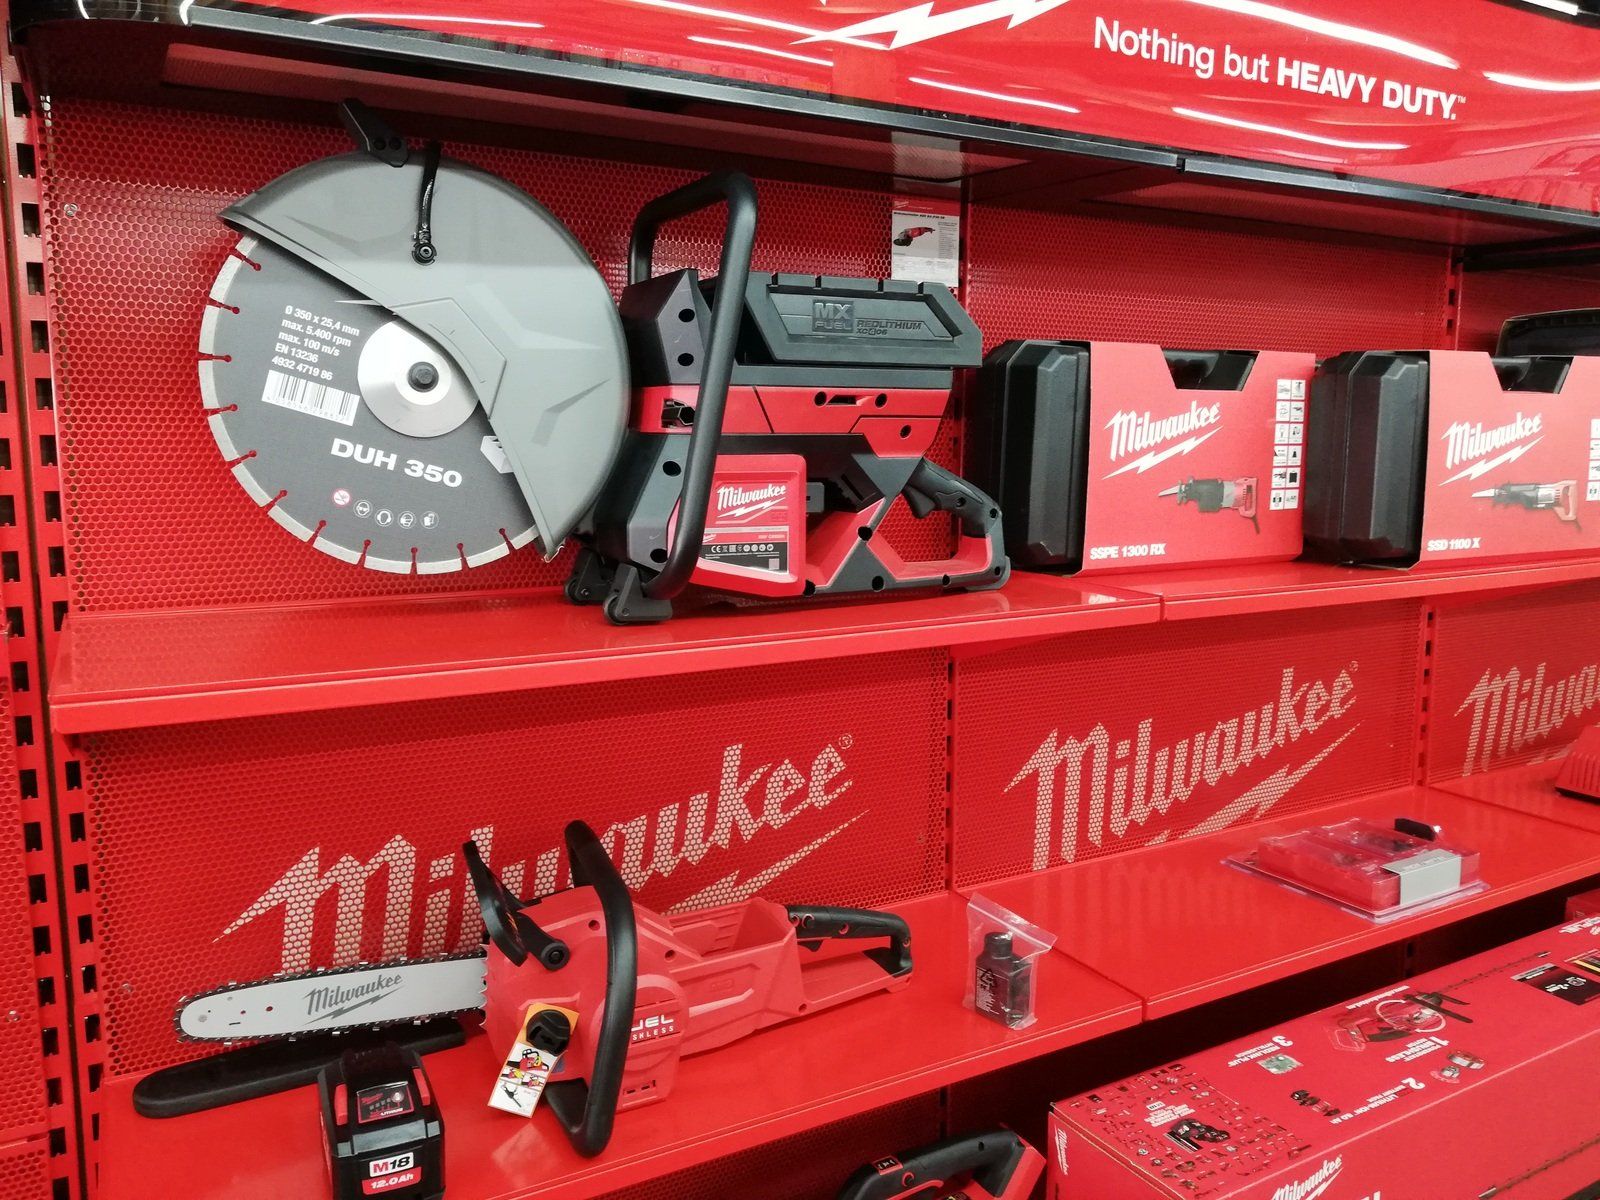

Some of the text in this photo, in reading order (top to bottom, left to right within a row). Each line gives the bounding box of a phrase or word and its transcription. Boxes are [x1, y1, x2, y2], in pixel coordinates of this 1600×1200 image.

[1093, 16, 1215, 80] Nothing
[1223, 44, 1270, 83] but
[1276, 56, 1378, 104] HEAVY
[814, 302, 852, 320] MX
[294, 308, 312, 321] 350
[313, 315, 320, 323] x
[321, 317, 341, 331] 25,4
[341, 325, 360, 337] mm
[814, 321, 852, 331] FUEL
[856, 320, 922, 331] REDLITHIUM
[281, 318, 352, 348] max. 5.400 rpm
[275, 343, 319, 363] EN 13236
[278, 331, 340, 357] max. 100 m/s
[271, 355, 333, 381] 4932 4719 86
[1103, 400, 1221, 462] Milwaukee
[1441, 412, 1543, 470] Milwaukee
[330, 437, 463, 488] DUH 350
[717, 484, 786, 511] Milwaukee
[1090, 543, 1166, 560] SSPE 1300 RX
[1427, 537, 1481, 551] SSD 1100 X
[1454, 662, 1600, 777] Milwa
[302, 974, 403, 1016] Milwaukee
[631, 1014, 674, 1031] UEL
[632, 1025, 674, 1041] SHLESS
[1272, 1035, 1293, 1048] 3
[1429, 1036, 1450, 1046] 1
[1401, 1077, 1426, 1090] 2
[373, 1156, 411, 1174] M18
[370, 1172, 414, 1189] 12.0Ah
